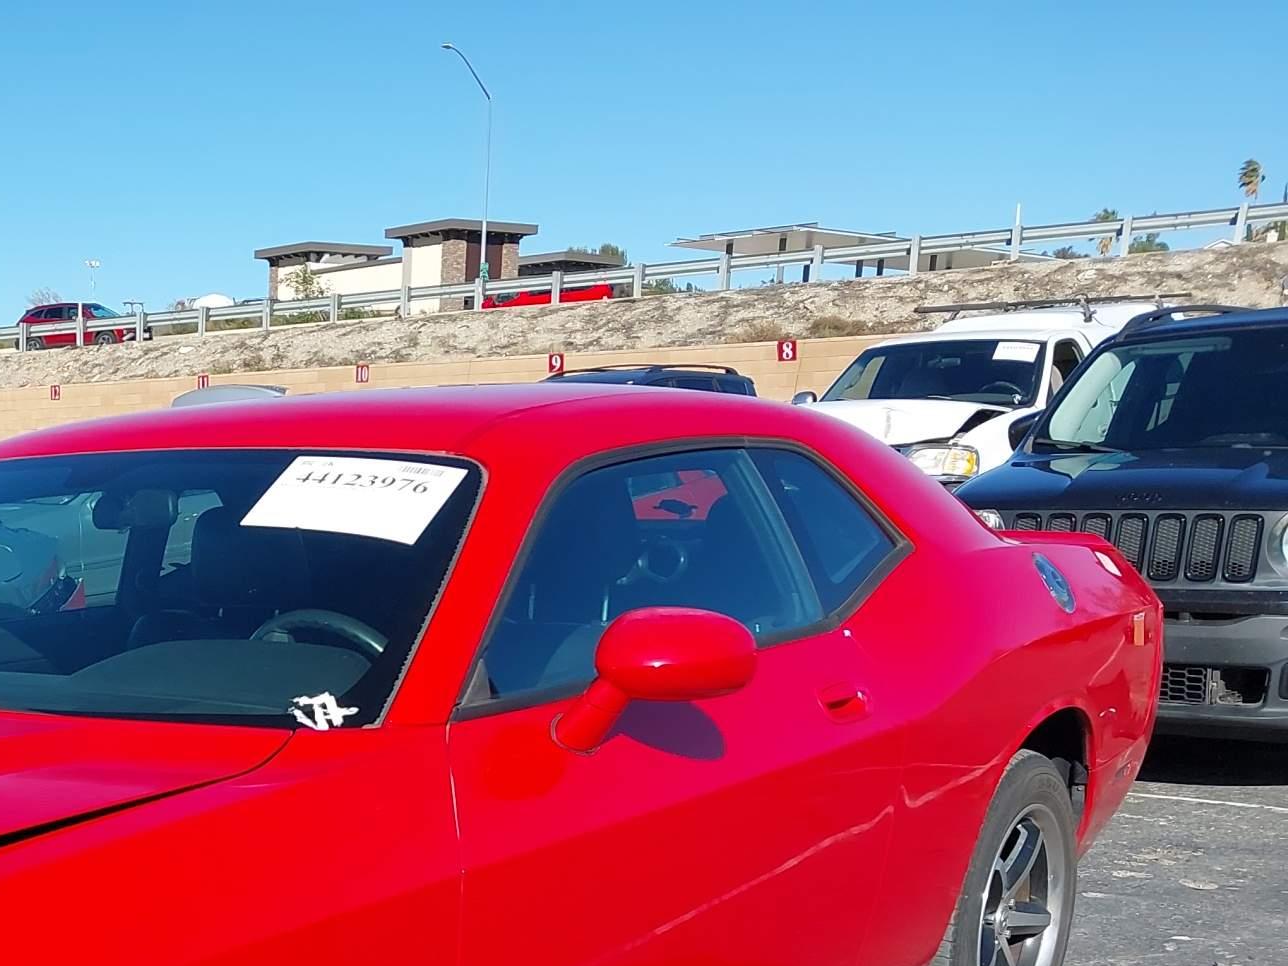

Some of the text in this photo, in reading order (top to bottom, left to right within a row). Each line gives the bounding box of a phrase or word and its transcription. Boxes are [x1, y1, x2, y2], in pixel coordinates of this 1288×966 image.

[782, 341, 793, 360] 8
[551, 355, 562, 372] 9
[356, 365, 369, 381] 10
[199, 376, 209, 389] 11
[51, 386, 60, 399] 12
[296, 471, 432, 493] 44123976
